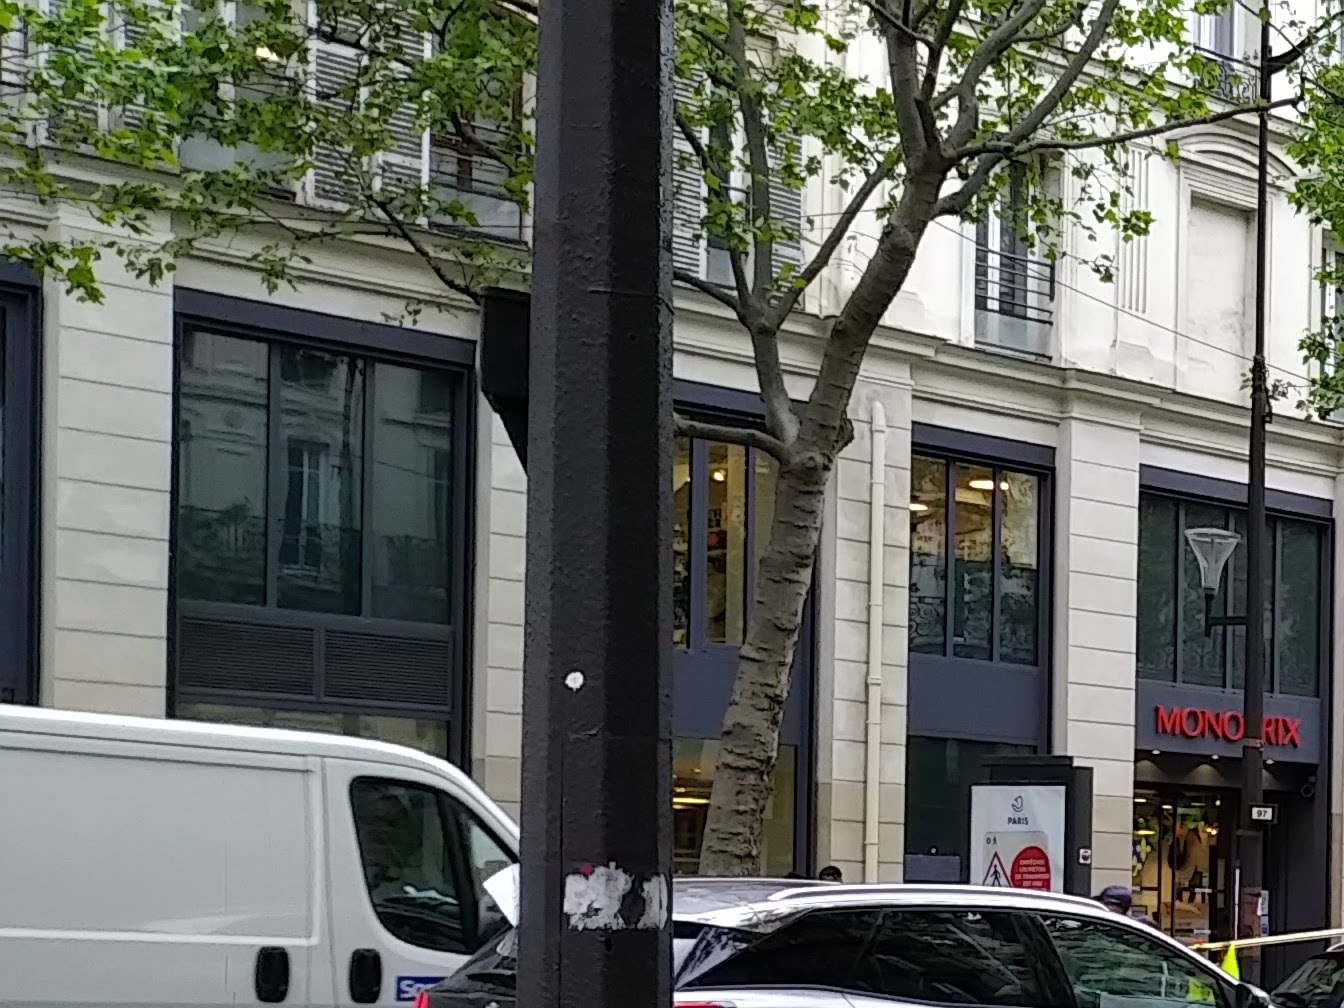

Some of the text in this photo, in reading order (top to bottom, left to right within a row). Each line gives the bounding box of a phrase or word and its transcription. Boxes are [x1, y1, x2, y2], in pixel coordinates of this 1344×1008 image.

[1155, 704, 1303, 748] MONORIX
[1256, 809, 1268, 818] 97
[1007, 816, 1029, 826] PARIS
